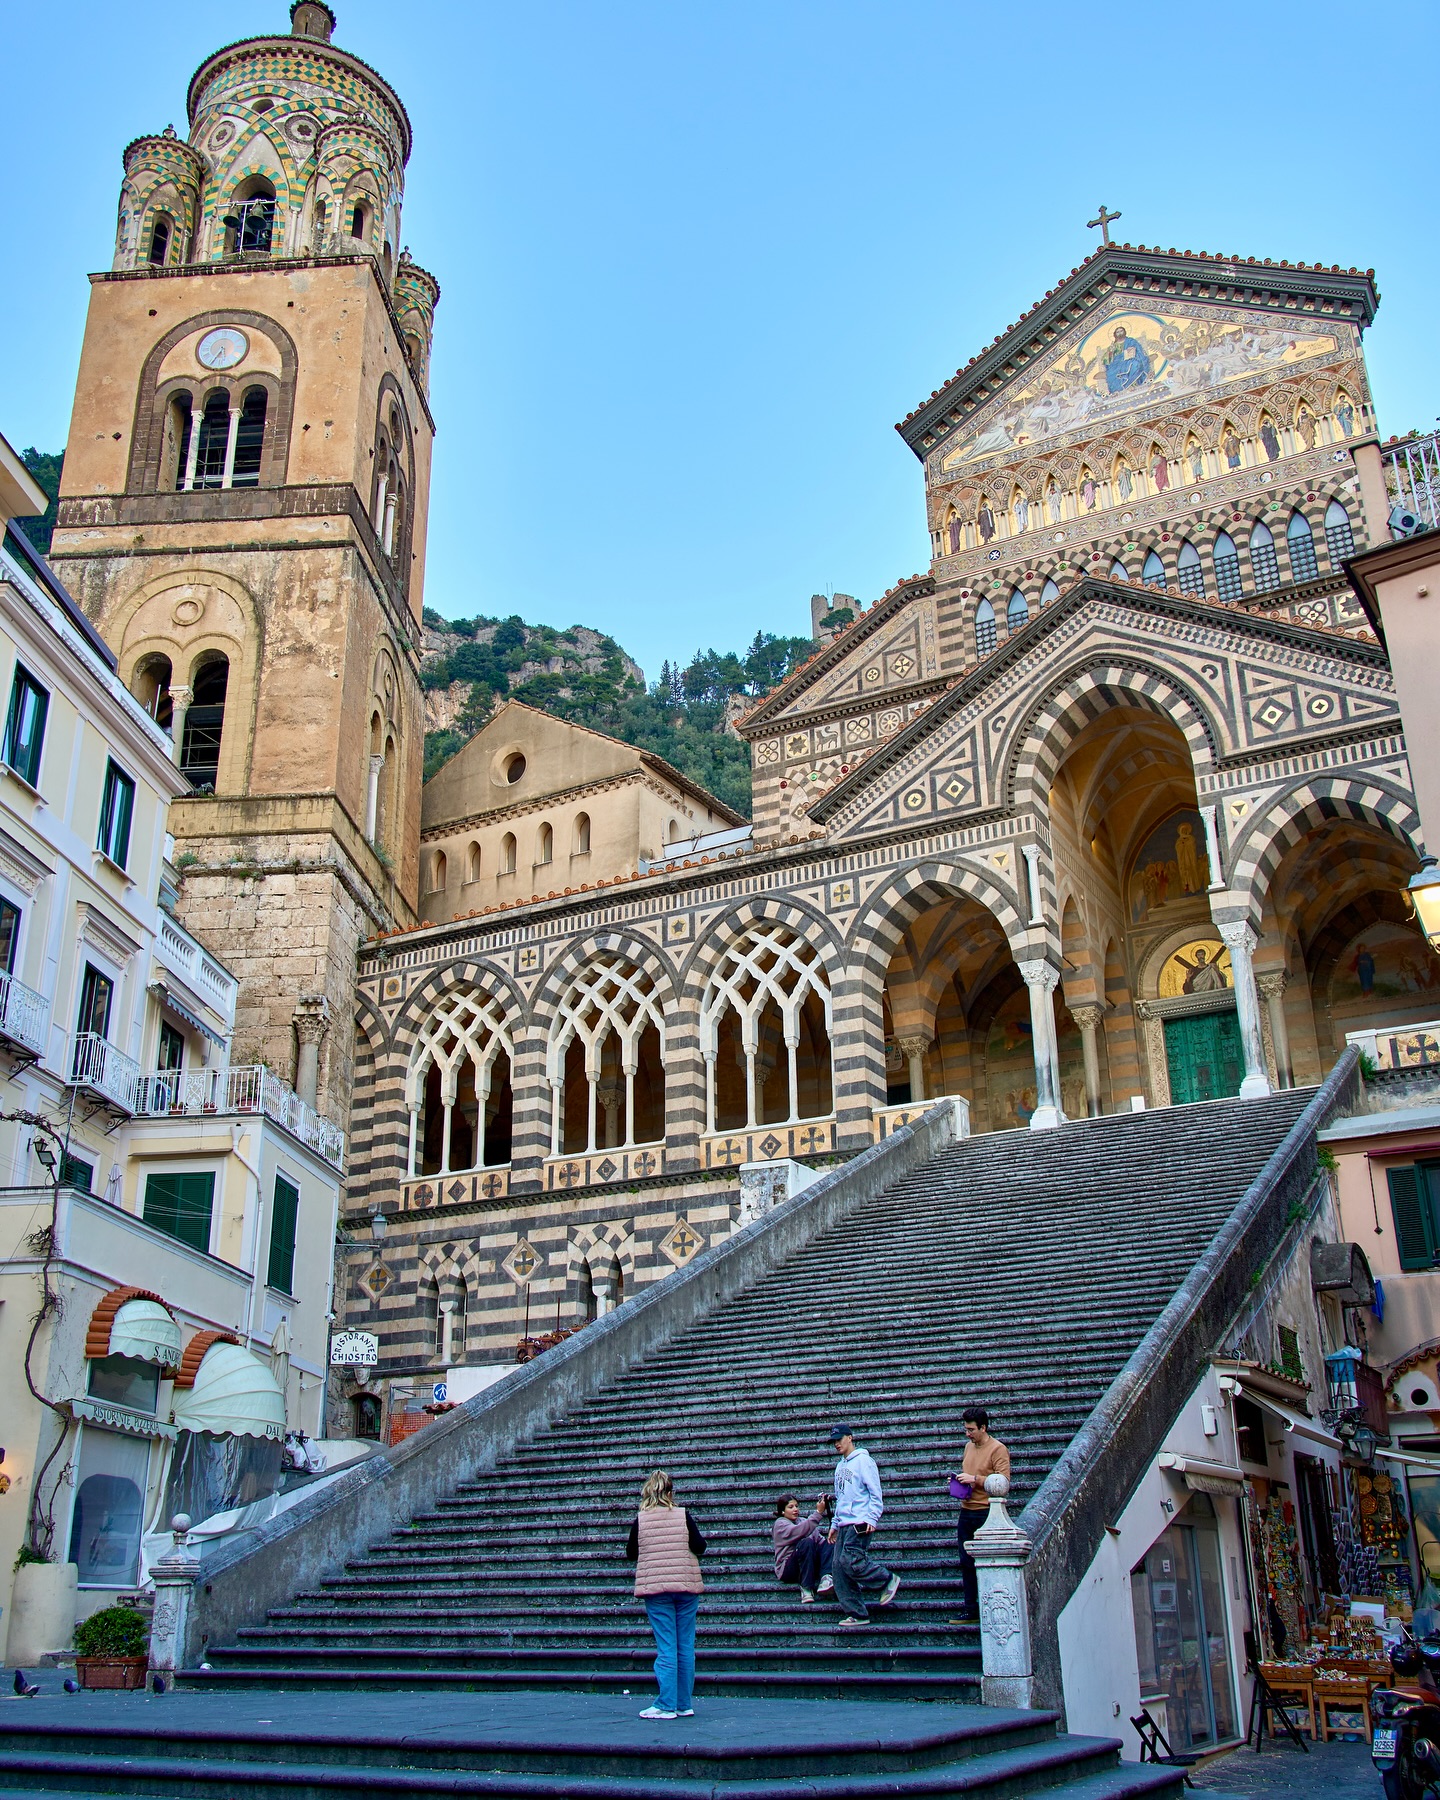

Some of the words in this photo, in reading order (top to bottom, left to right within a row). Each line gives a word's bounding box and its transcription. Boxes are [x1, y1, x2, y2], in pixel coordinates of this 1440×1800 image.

[334, 1332, 375, 1353] RISTORANTE
[331, 1353, 377, 1362] CHIOSTRO
[93, 1405, 131, 1426] RISTORANTE
[134, 1417, 160, 1432] PIZZERIA
[265, 1424, 280, 1436] DAL
